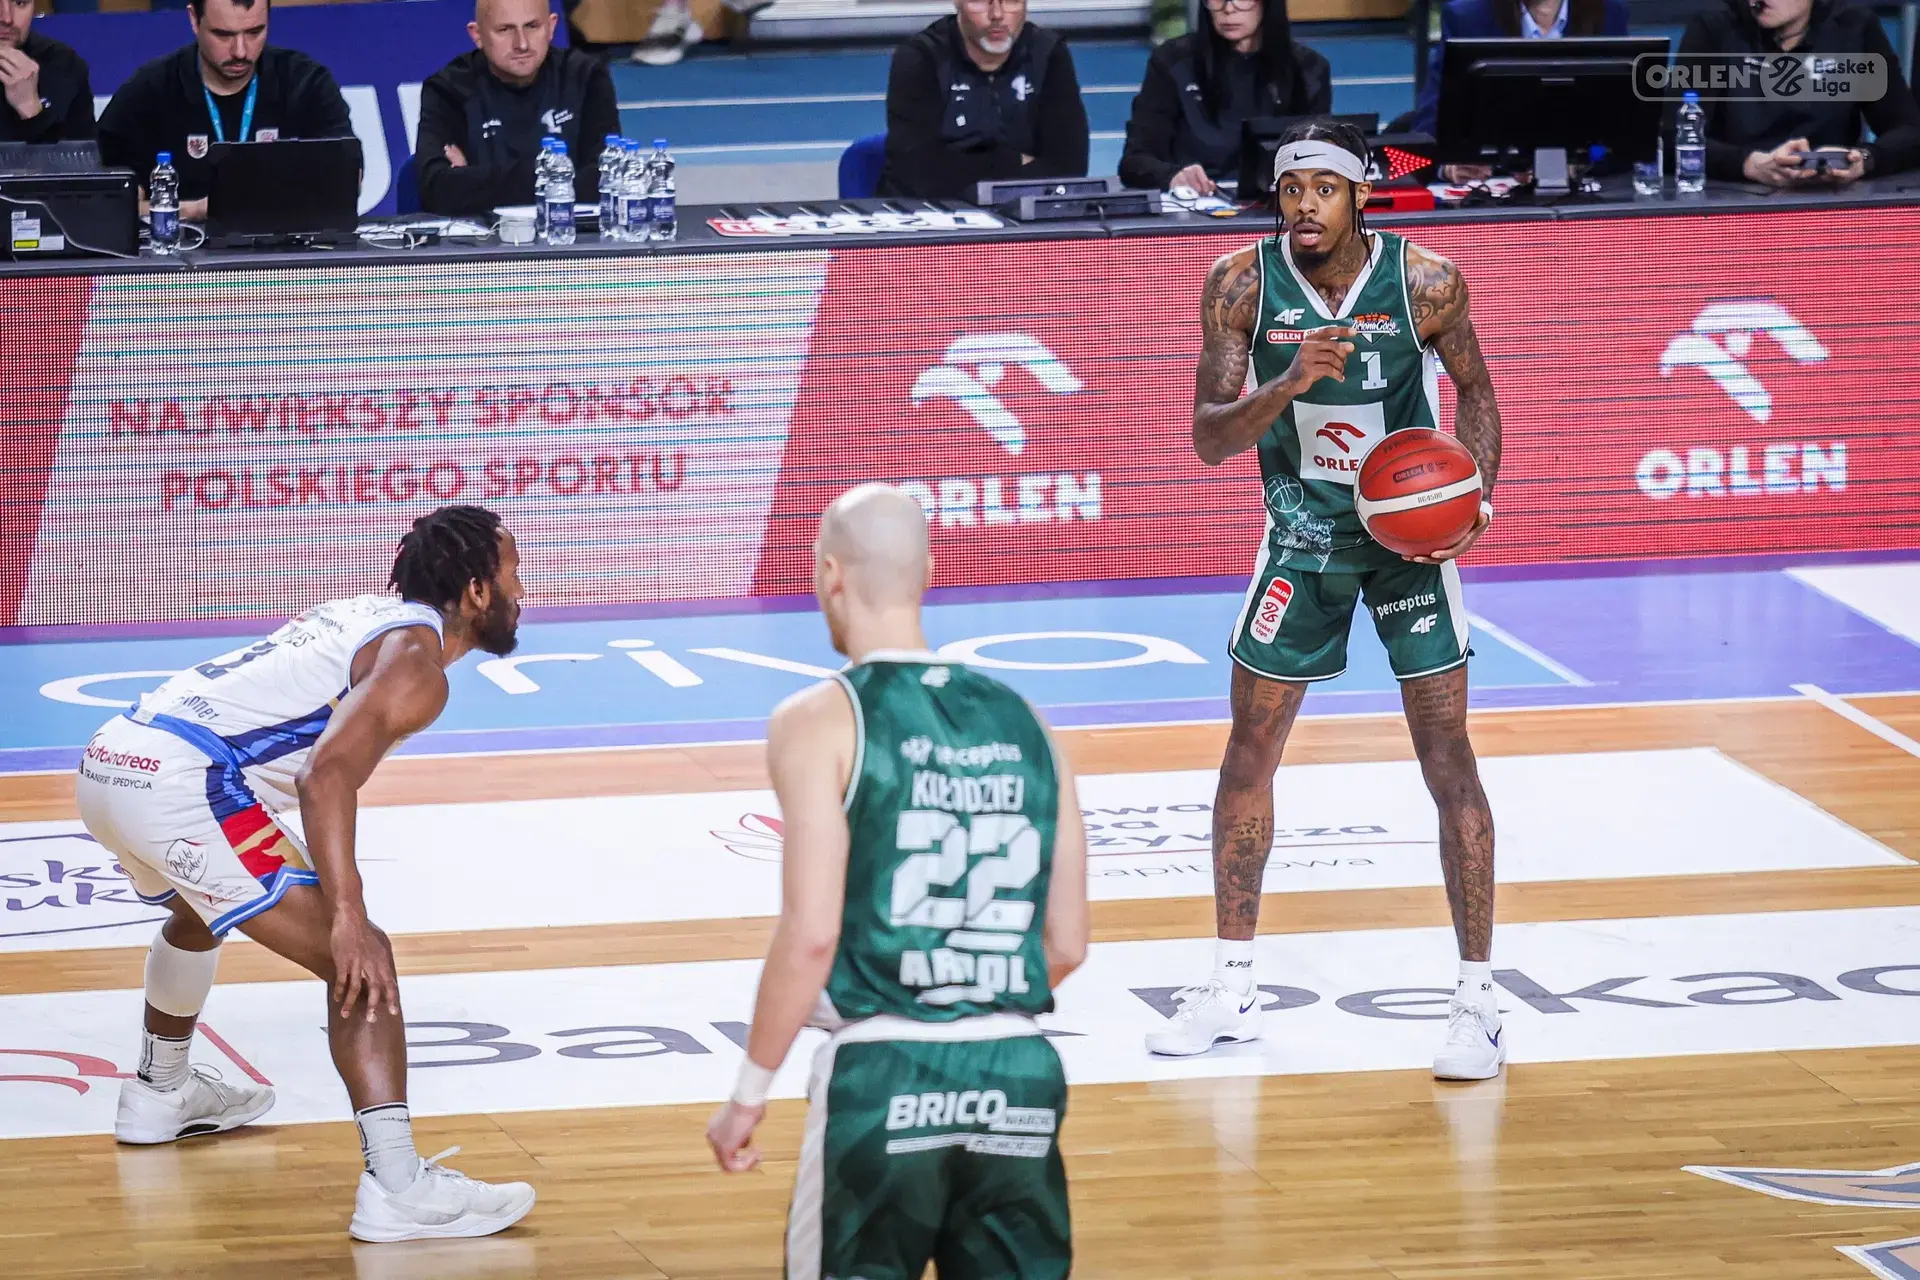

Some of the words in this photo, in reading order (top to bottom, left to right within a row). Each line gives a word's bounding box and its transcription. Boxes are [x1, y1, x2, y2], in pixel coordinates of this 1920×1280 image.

[1274, 308, 1305, 325] 4F
[1270, 333, 1301, 341] ORLEN
[1360, 351, 1388, 390] 1
[474, 376, 734, 428] SPONSOR
[1313, 455, 1361, 472] ORLE
[1635, 443, 1848, 500] ORLEN
[163, 461, 467, 512] POLSKIEGO
[484, 453, 686, 498] SPORTU
[1417, 491, 1443, 504] BG4500
[1271, 584, 1291, 600] ORLEN
[1376, 592, 1436, 620] perceptus
[1254, 618, 1274, 634] Basket
[1255, 626, 1268, 638] Liga
[1410, 613, 1438, 635] 4F
[112, 776, 153, 790] SPEDYCJA
[169, 846, 195, 874] Polski
[889, 809, 1041, 932] 22
[886, 1089, 1008, 1131] BRICO
